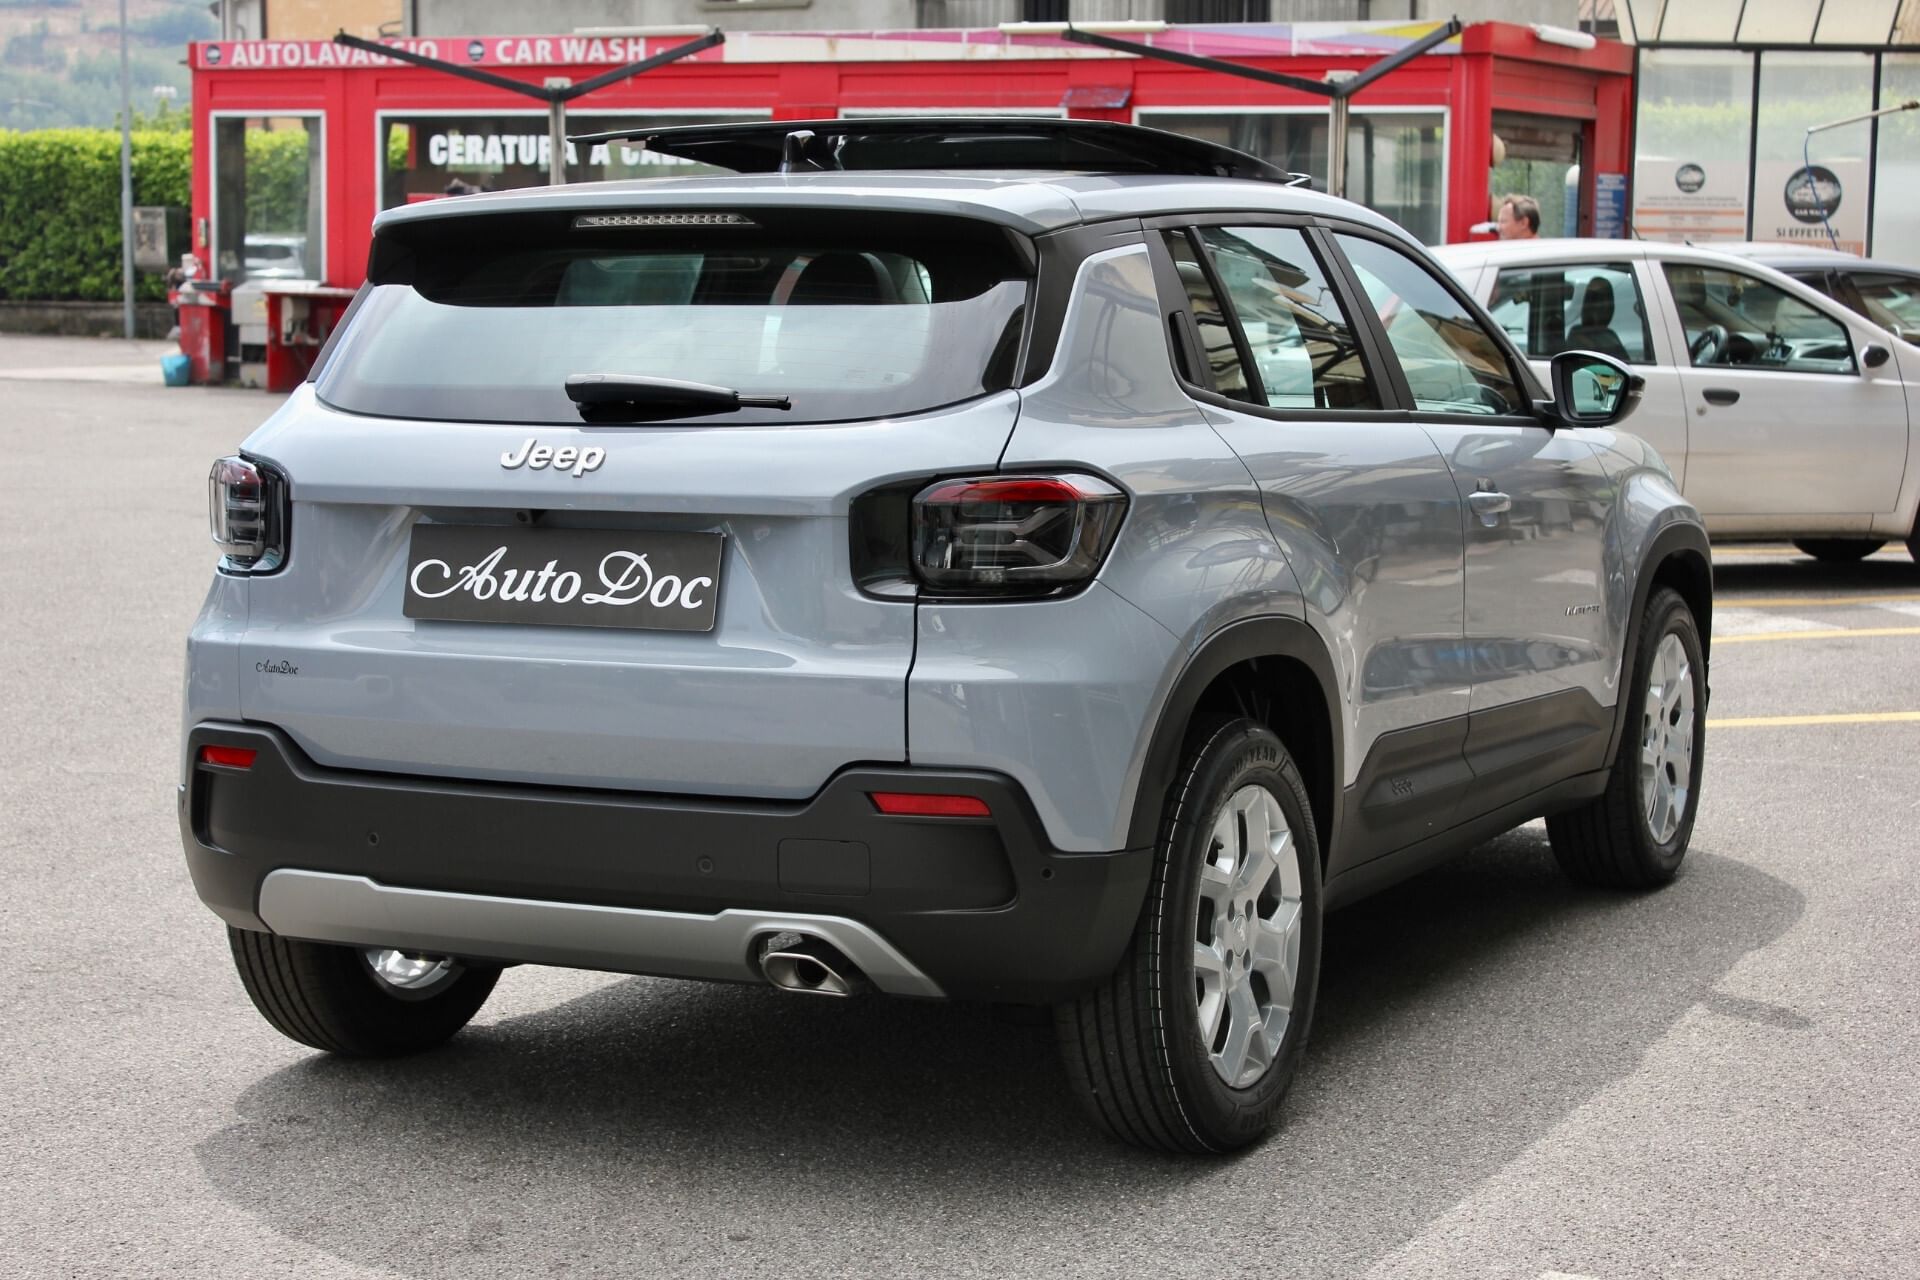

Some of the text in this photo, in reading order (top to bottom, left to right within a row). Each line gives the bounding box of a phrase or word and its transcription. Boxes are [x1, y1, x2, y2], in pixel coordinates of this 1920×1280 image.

[495, 38, 553, 64] CAR
[560, 36, 646, 63] WASH
[500, 438, 607, 479] Jeep
